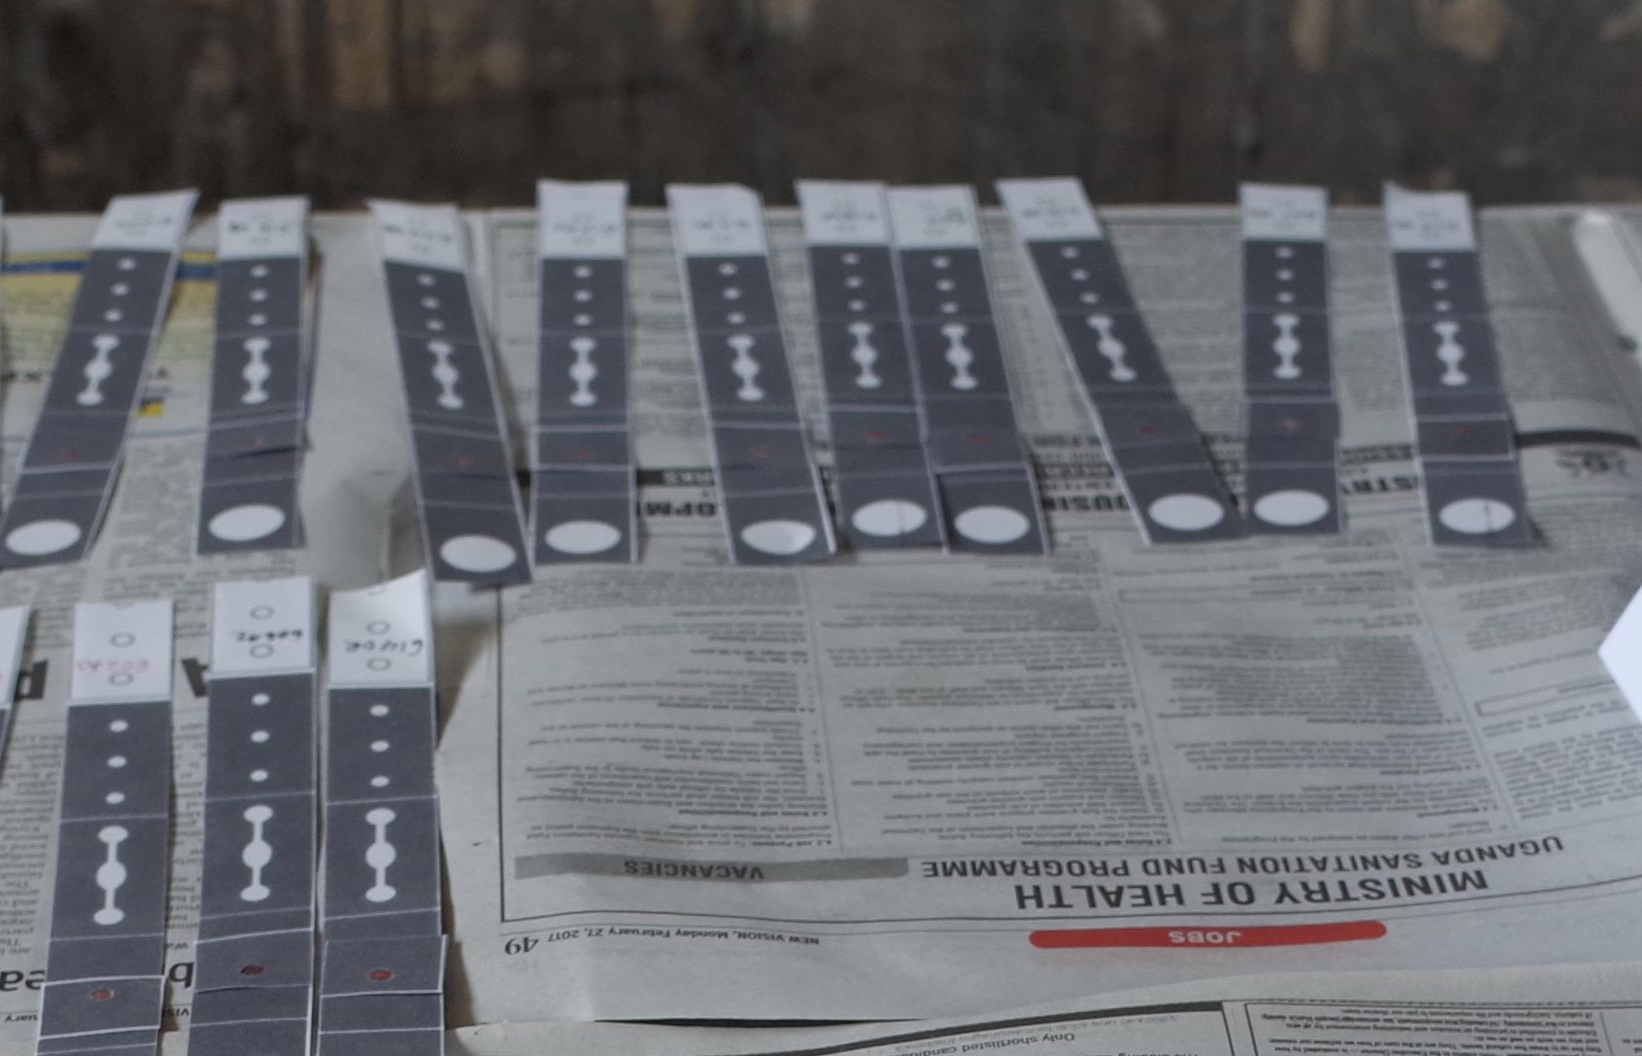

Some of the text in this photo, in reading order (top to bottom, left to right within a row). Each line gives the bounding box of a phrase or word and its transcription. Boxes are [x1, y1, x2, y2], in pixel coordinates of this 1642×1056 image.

[922, 835, 1564, 880] UGANDA SANITATION FUND PROGRAMME
[624, 859, 765, 882] VACANCIES
[1014, 868, 1489, 911] MINISTRY OF HEALTH
[504, 934, 540, 957] 49
[547, 925, 820, 947] NEW VISION, Monday February 27, 2017
[1168, 927, 1242, 945] JOBS
